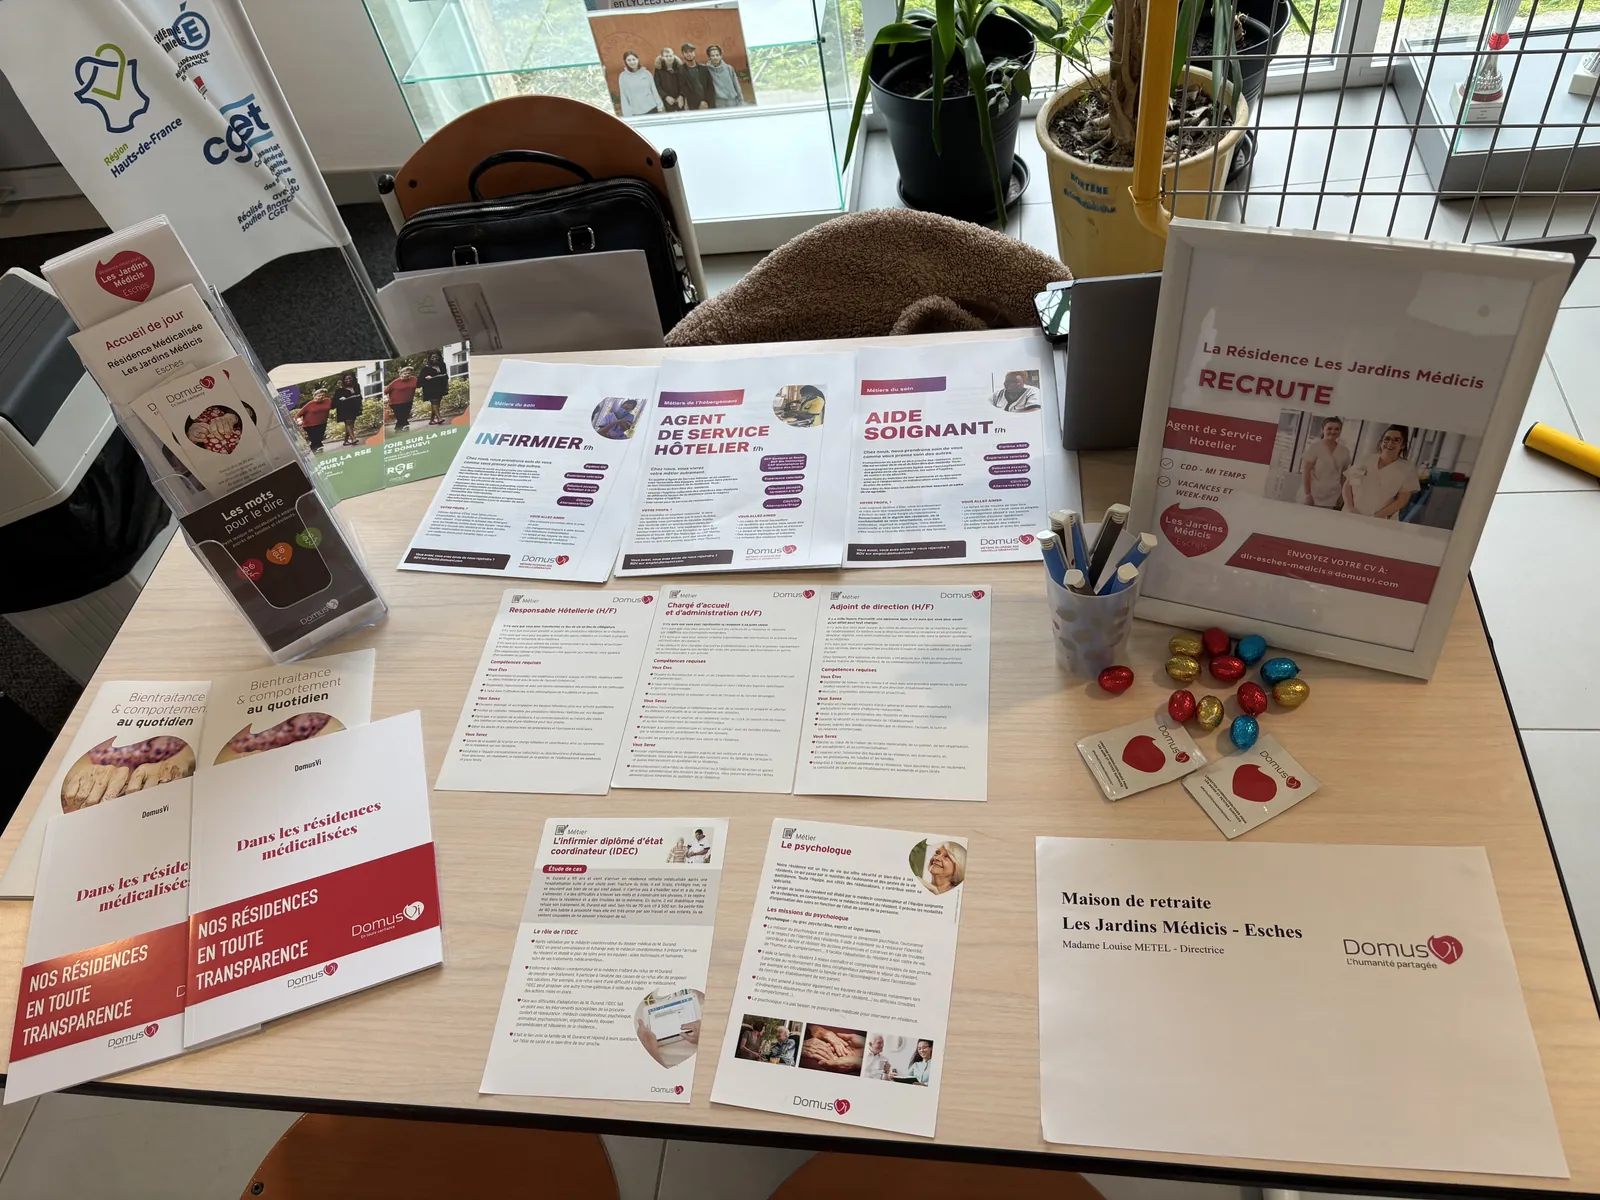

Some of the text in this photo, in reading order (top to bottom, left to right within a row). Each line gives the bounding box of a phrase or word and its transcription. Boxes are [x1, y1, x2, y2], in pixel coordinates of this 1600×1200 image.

[203, 103, 270, 165] cget
[104, 142, 129, 166] Région
[110, 117, 183, 178] Hauts-de-France
[237, 200, 263, 225] Réalisé
[241, 209, 266, 232] soutien
[268, 204, 289, 221] CGET
[101, 273, 116, 284] Les
[119, 261, 148, 276] Jardins
[114, 272, 144, 288] Médicis
[123, 283, 150, 297] Esches
[105, 310, 184, 350] Accueil de jour
[108, 324, 203, 369] Résidence Médicalisée
[122, 337, 203, 376] Les Jardins Médicis
[1202, 342, 1484, 389] La Résidence Les Jardins Médicis
[155, 359, 184, 375] Esches
[1198, 369, 1334, 405] RECRUTE
[660, 414, 726, 425] AGENT
[865, 410, 922, 424] AIDE
[405, 428, 457, 445] SUR LA RSE
[658, 426, 770, 440] DE SERVICE
[864, 421, 993, 440] SOIGNANT
[1167, 419, 1262, 442] Agent de Service
[475, 432, 584, 450] INFIRMIER
[655, 441, 749, 455] HÔTELIER
[1189, 436, 1236, 451] Hotelier
[1180, 462, 1247, 480] CDD MI TEMPS
[1175, 488, 1219, 502] WEEK-END
[1177, 479, 1234, 495] VACANCES ET
[221, 489, 274, 521] Les mots
[224, 496, 283, 534] pour le dire
[1165, 515, 1223, 533] Les Jardins
[1174, 526, 1211, 540] Médicis
[1240, 552, 1399, 588] dir-esches-medicis@domusvi.com
[1287, 549, 1329, 564] ENVOYEZ
[1331, 557, 1361, 569] VOTRE
[1364, 562, 1377, 572] CV
[250, 667, 331, 690] Bientraitance
[129, 692, 205, 702] Bientraitance
[237, 678, 341, 704] & comportement
[112, 705, 121, 714] &
[247, 692, 329, 715] au quotidien
[117, 716, 193, 728] au quotidien
[295, 759, 322, 772] DomusVi
[142, 805, 169, 819] DomusVi
[236, 801, 382, 853] Dans les résidences
[261, 826, 358, 862] médicalisées
[553, 837, 663, 846] L'infirmier diplômé d'état
[796, 833, 816, 841] Métier
[551, 847, 638, 856] coordinateur (IDEC)
[781, 841, 851, 856] Le psychologue
[76, 882, 115, 902] Dans
[118, 876, 140, 889] les
[1062, 892, 1211, 910] Maison de retraite
[198, 889, 319, 939] NOS RÉSIDENCES
[813, 912, 849, 921] psychologue
[1062, 917, 1303, 939] Les Jardins Médicis Esches
[197, 930, 264, 965] EN TOUTE
[1062, 940, 1224, 955] Madame Louise METEL Directrice
[29, 945, 148, 993] NOS RÉSIDENCES
[196, 941, 309, 991] TRANSPARENCE
[1346, 957, 1438, 970] L'humanité partagée
[26, 987, 91, 1019] EN TOUTE
[22, 1000, 133, 1046] TRANSPARENCE
